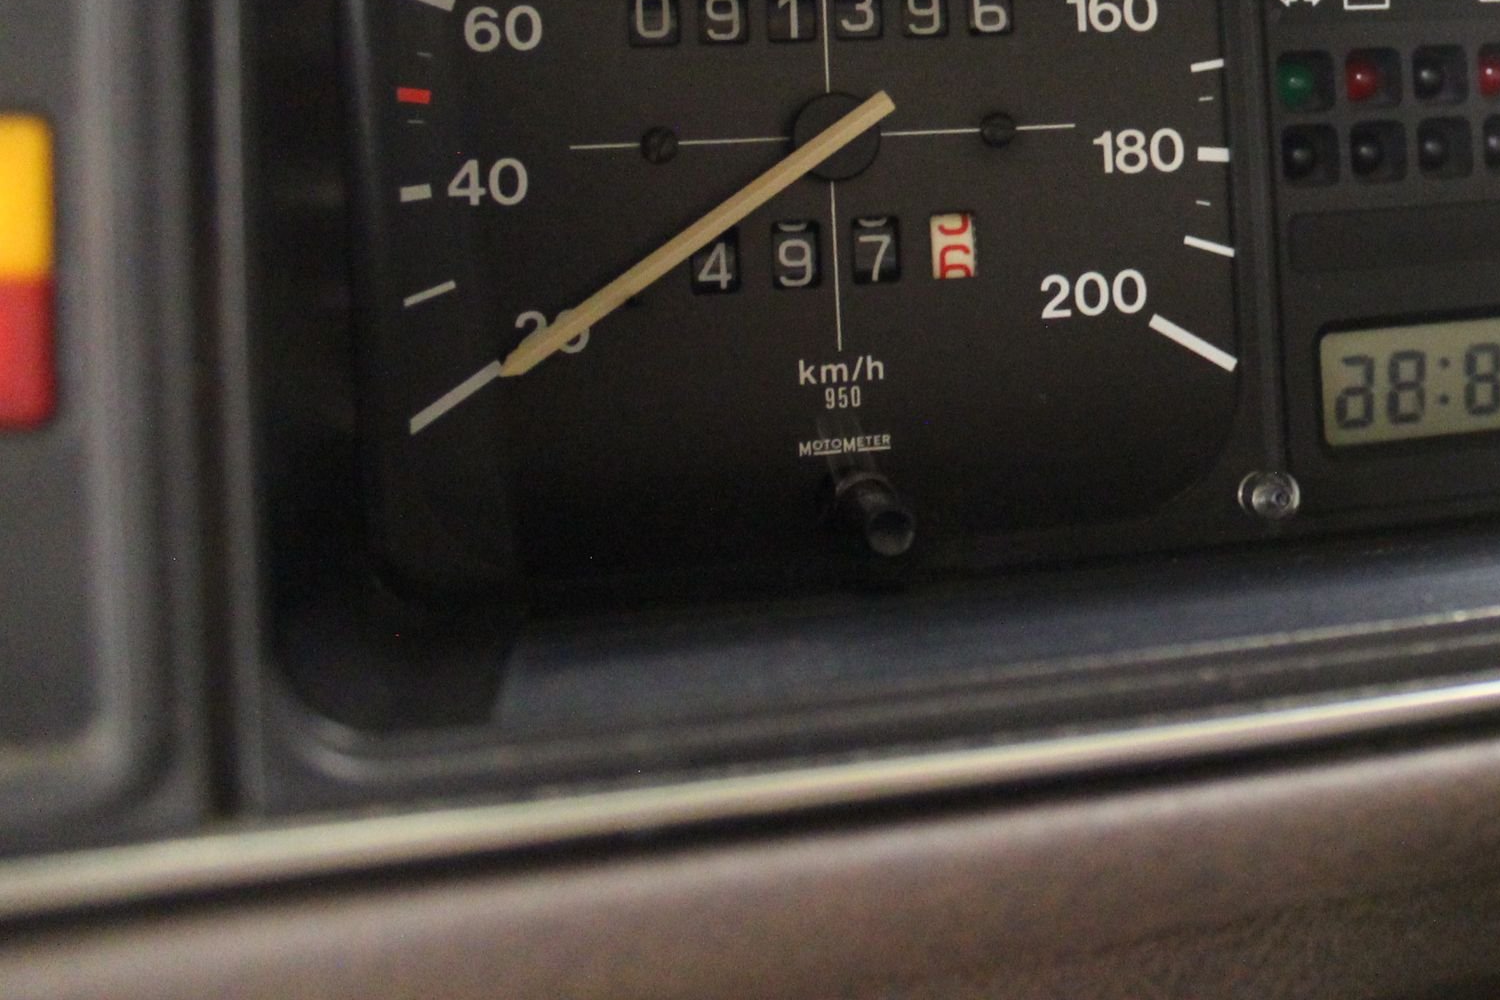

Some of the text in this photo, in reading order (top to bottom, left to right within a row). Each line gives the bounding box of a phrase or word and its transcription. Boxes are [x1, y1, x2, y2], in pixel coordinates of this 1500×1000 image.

[464, 4, 543, 53] 60
[1092, 127, 1185, 174] 180
[447, 157, 529, 206] 40
[1040, 268, 1147, 319] 200
[798, 355, 885, 385] km/h
[824, 385, 861, 409] 950
